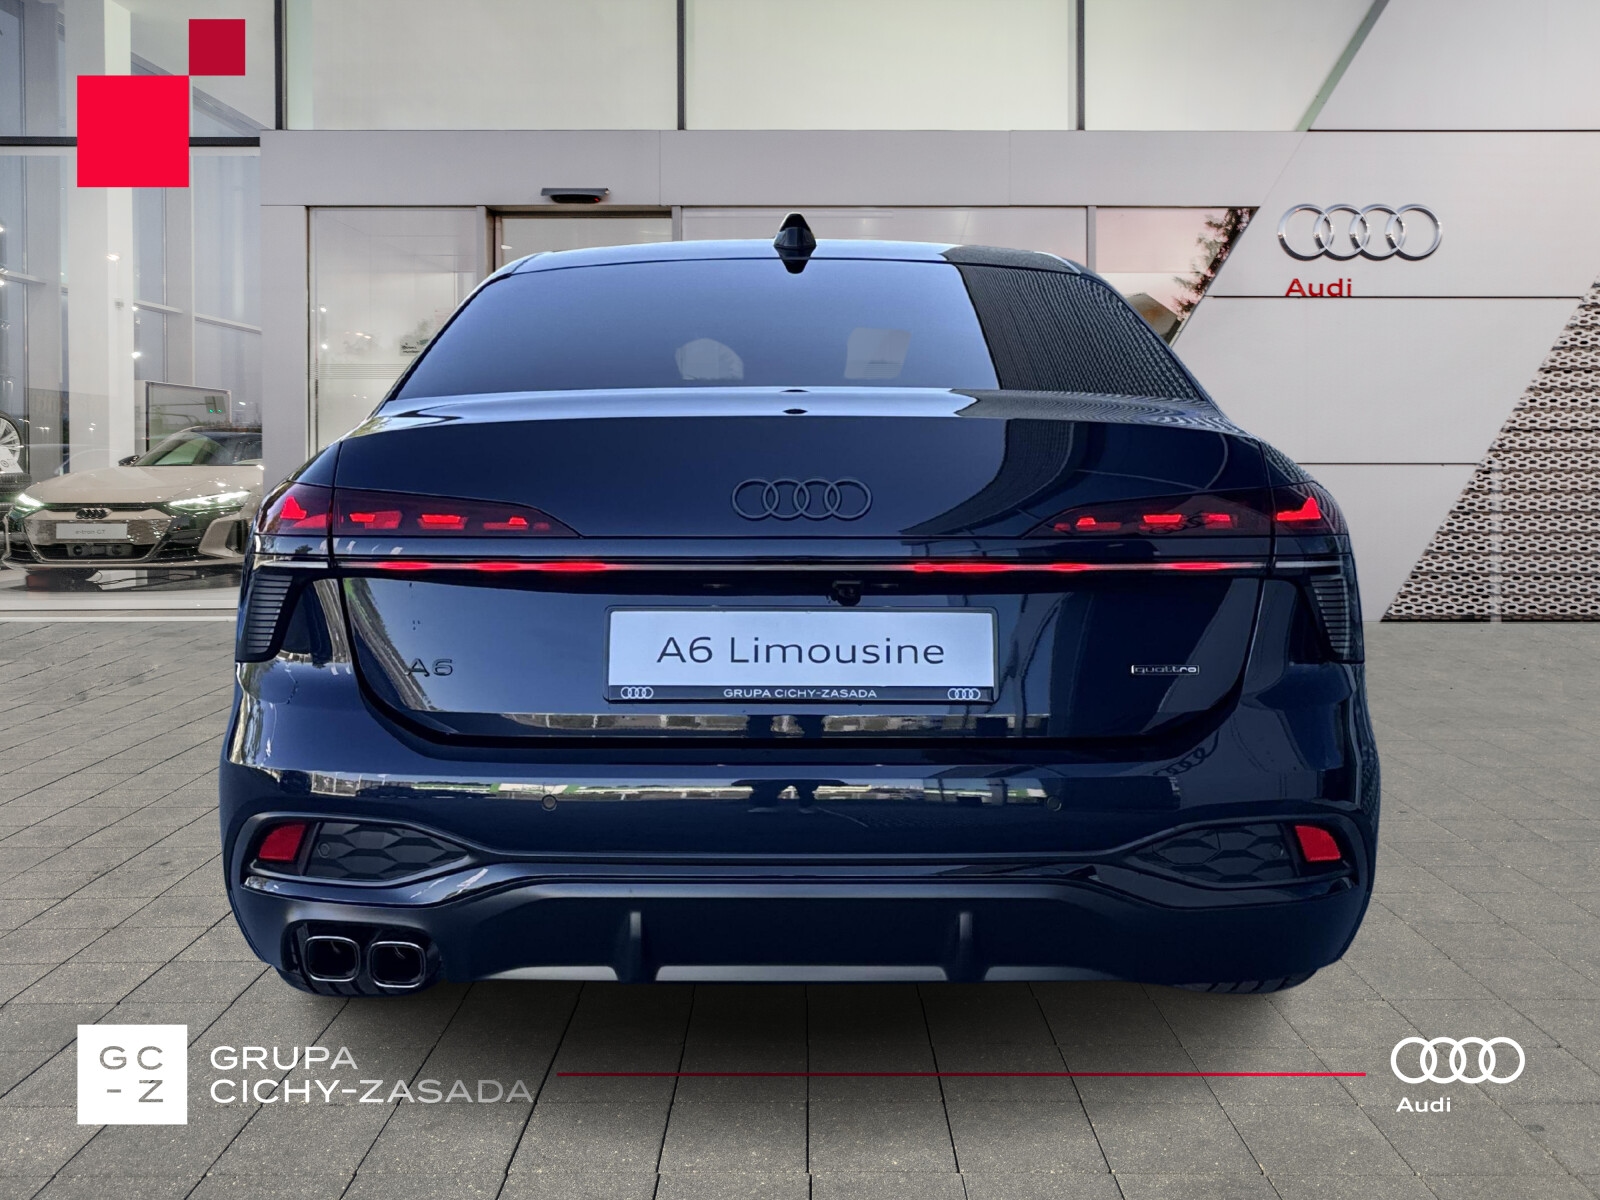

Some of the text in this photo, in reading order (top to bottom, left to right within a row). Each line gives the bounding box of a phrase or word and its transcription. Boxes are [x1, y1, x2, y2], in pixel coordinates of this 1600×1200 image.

[1285, 278, 1352, 297] Audi
[656, 636, 945, 664] A6 Limousine
[407, 658, 454, 677] A6
[1134, 665, 1197, 674] quattro
[723, 688, 878, 699] GRUPA CICHY-ZASADA
